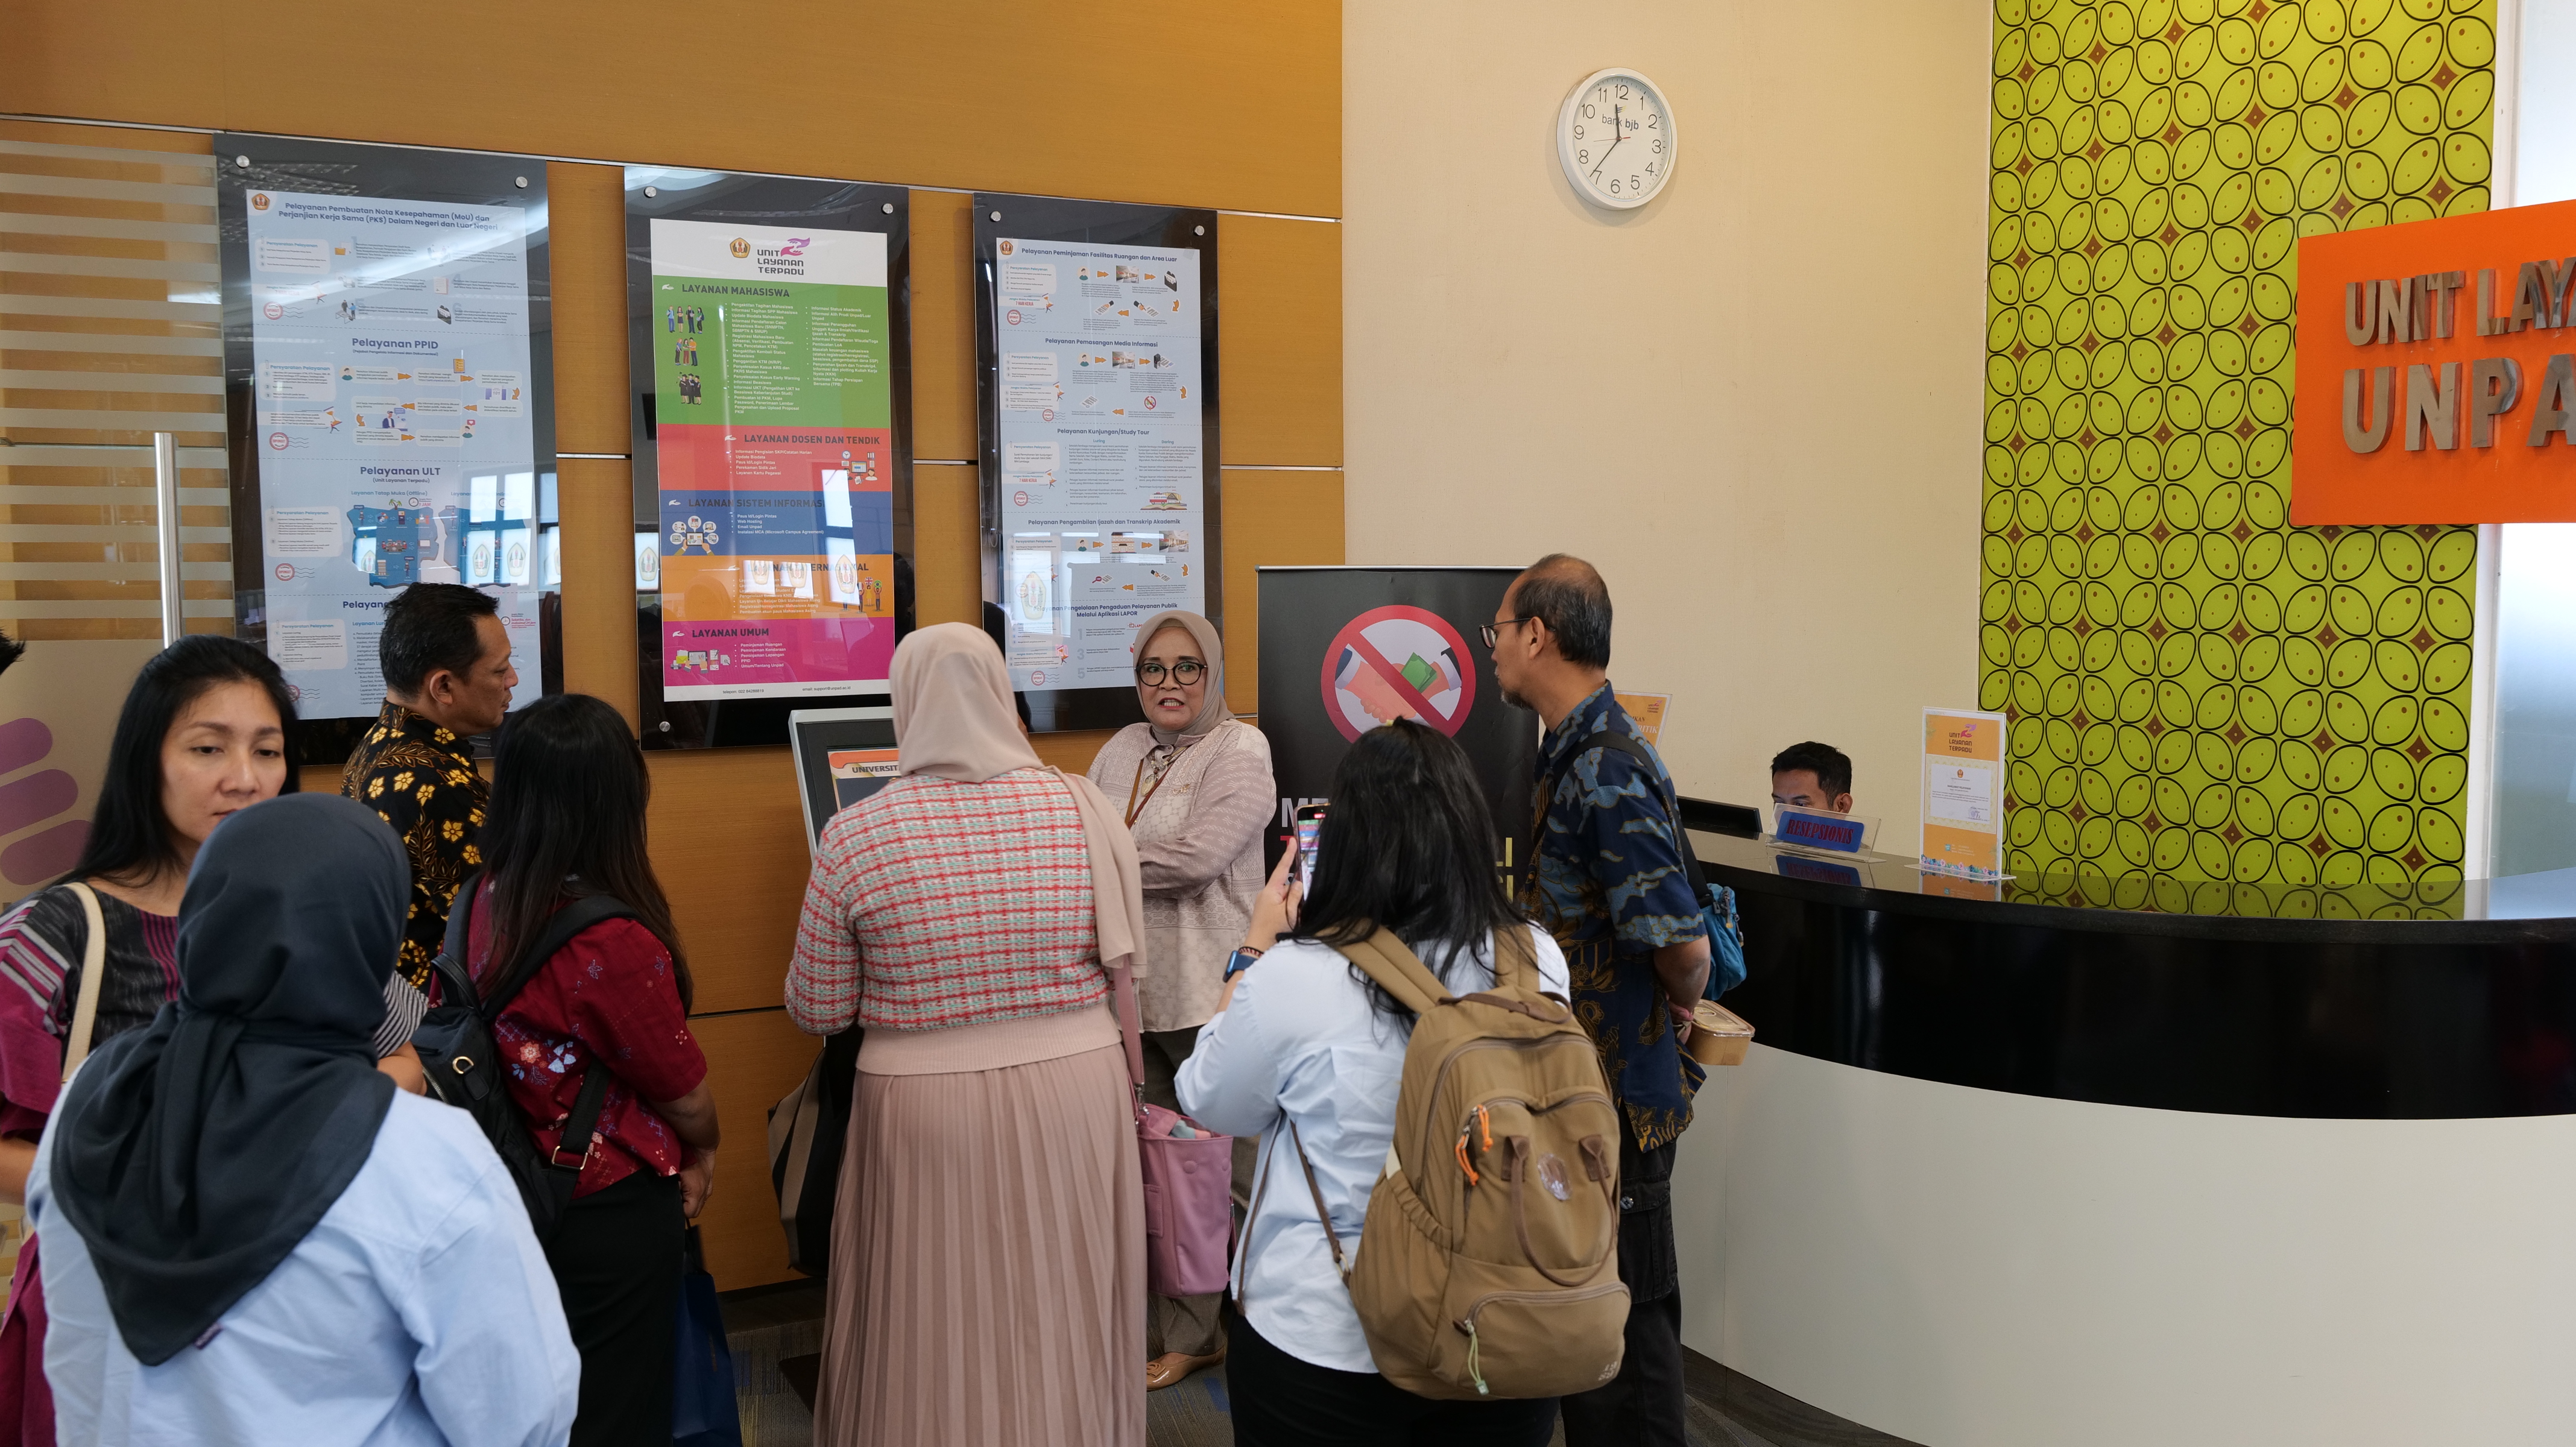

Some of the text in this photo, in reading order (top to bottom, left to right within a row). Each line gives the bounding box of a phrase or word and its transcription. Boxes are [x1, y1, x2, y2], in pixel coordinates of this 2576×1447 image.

[1598, 87, 1607, 103] 11
[1615, 84, 1629, 100] 12
[1640, 96, 1644, 110] 1
[1581, 103, 1596, 119] 10
[1602, 114, 1639, 131] bank bjb
[1648, 114, 1658, 129] 2
[1574, 125, 1584, 140] 9
[1652, 139, 1661, 154] 3
[1579, 150, 1589, 164] 8
[1645, 162, 1654, 176] 4
[1593, 169, 1602, 185] 7
[1631, 174, 1640, 190] 5
[1611, 179, 1620, 194] 6
[285, 202, 327, 213] Pelayanan
[328, 205, 374, 215] Pembuatan
[394, 209, 450, 219] Kesepahaman
[451, 213, 474, 222] (MoU)
[475, 214, 490, 222] dan
[278, 210, 318, 221] Perjanjian
[320, 213, 340, 223] Kerja
[341, 214, 364, 222] Sama
[365, 216, 387, 225] (PKS)
[388, 217, 414, 225] Dalam
[414, 219, 439, 229] Negeri
[440, 220, 455, 229] dan
[472, 222, 497, 232] Negeri
[757, 248, 780, 257] UNIT
[1021, 248, 1052, 256] Pelayanan
[1053, 250, 1089, 259] Peminjaman
[1114, 253, 1139, 262] Ruangan
[757, 257, 804, 267] LAYANAN
[758, 266, 804, 276] TERPADU
[681, 283, 790, 298] LAYANAN MAHASISWA
[2345, 256, 2576, 347] UNIT LAY
[352, 337, 438, 350] Pelayanan PPID
[1045, 338, 1076, 346] Pelayanan
[1076, 339, 1113, 347] Pemasangan
[744, 434, 880, 445] LAYANAN DOSEN DAN TENDIK
[1088, 429, 1137, 437] Kunjungan/Study
[360, 467, 441, 478] Pelayanan ULT
[689, 499, 734, 508] LAYANAN
[736, 499, 771, 508] SISTEM
[343, 601, 388, 610] Pelayan
[1099, 604, 1131, 612] Pengaduan
[692, 628, 769, 638] LAYANAN UMUM
[1638, 725, 1658, 734] RITIK
[851, 764, 900, 774] UNIVERSIT
[1785, 819, 1854, 844] RESEPSIONIS
